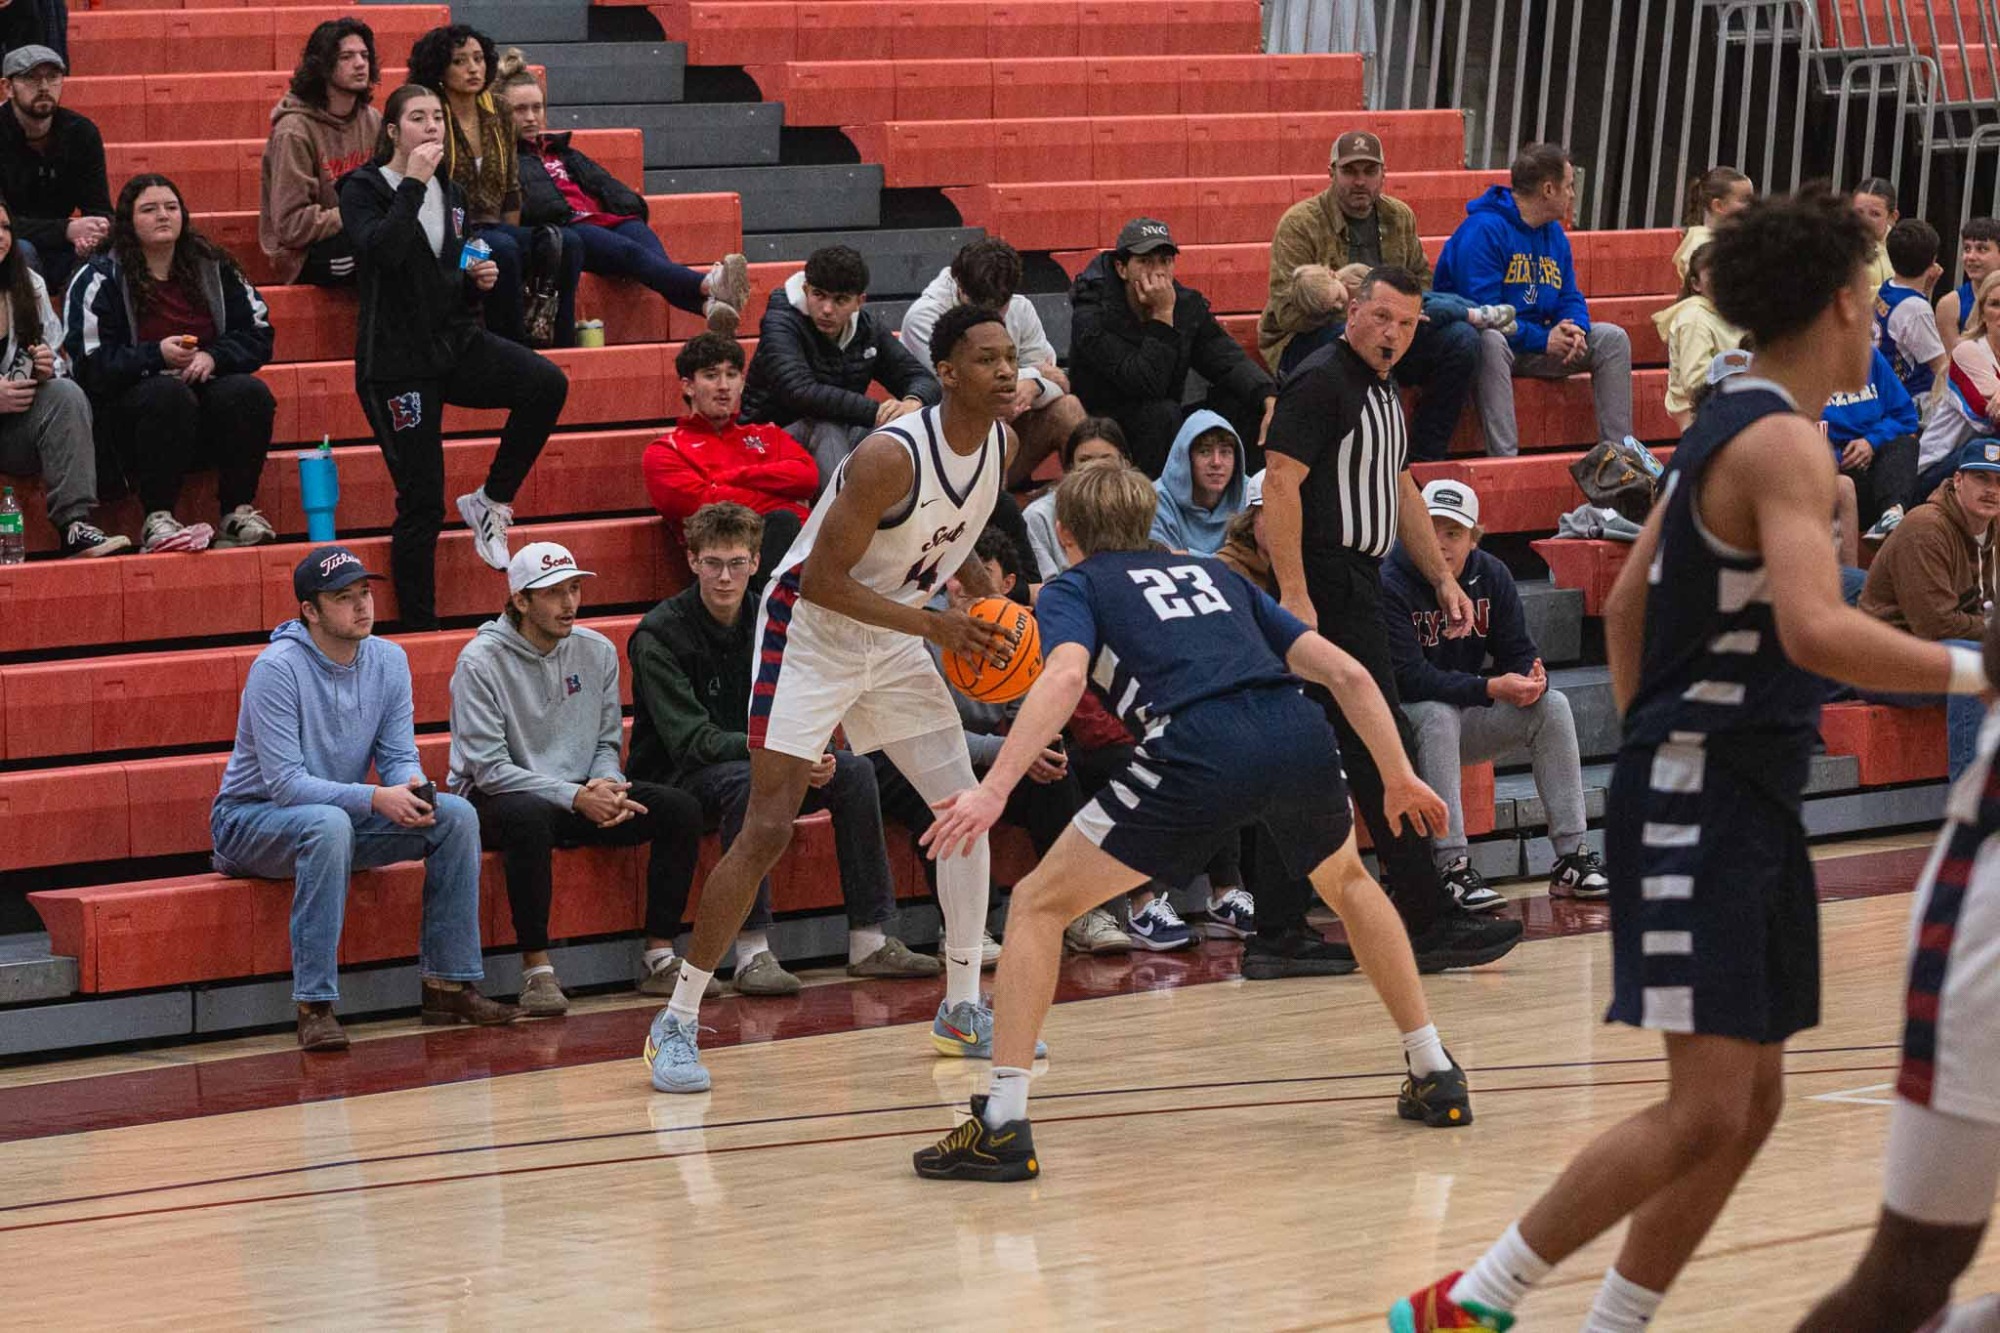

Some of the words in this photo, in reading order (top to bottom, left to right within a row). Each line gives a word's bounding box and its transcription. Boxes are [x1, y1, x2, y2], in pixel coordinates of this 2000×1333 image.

[1504, 260, 1562, 290] BLARS
[320, 552, 363, 577] Titlei
[541, 554, 573, 571] Scots
[1127, 564, 1233, 621] 23
[989, 611, 1028, 671] Wlson
[1412, 598, 1490, 647] LYN
